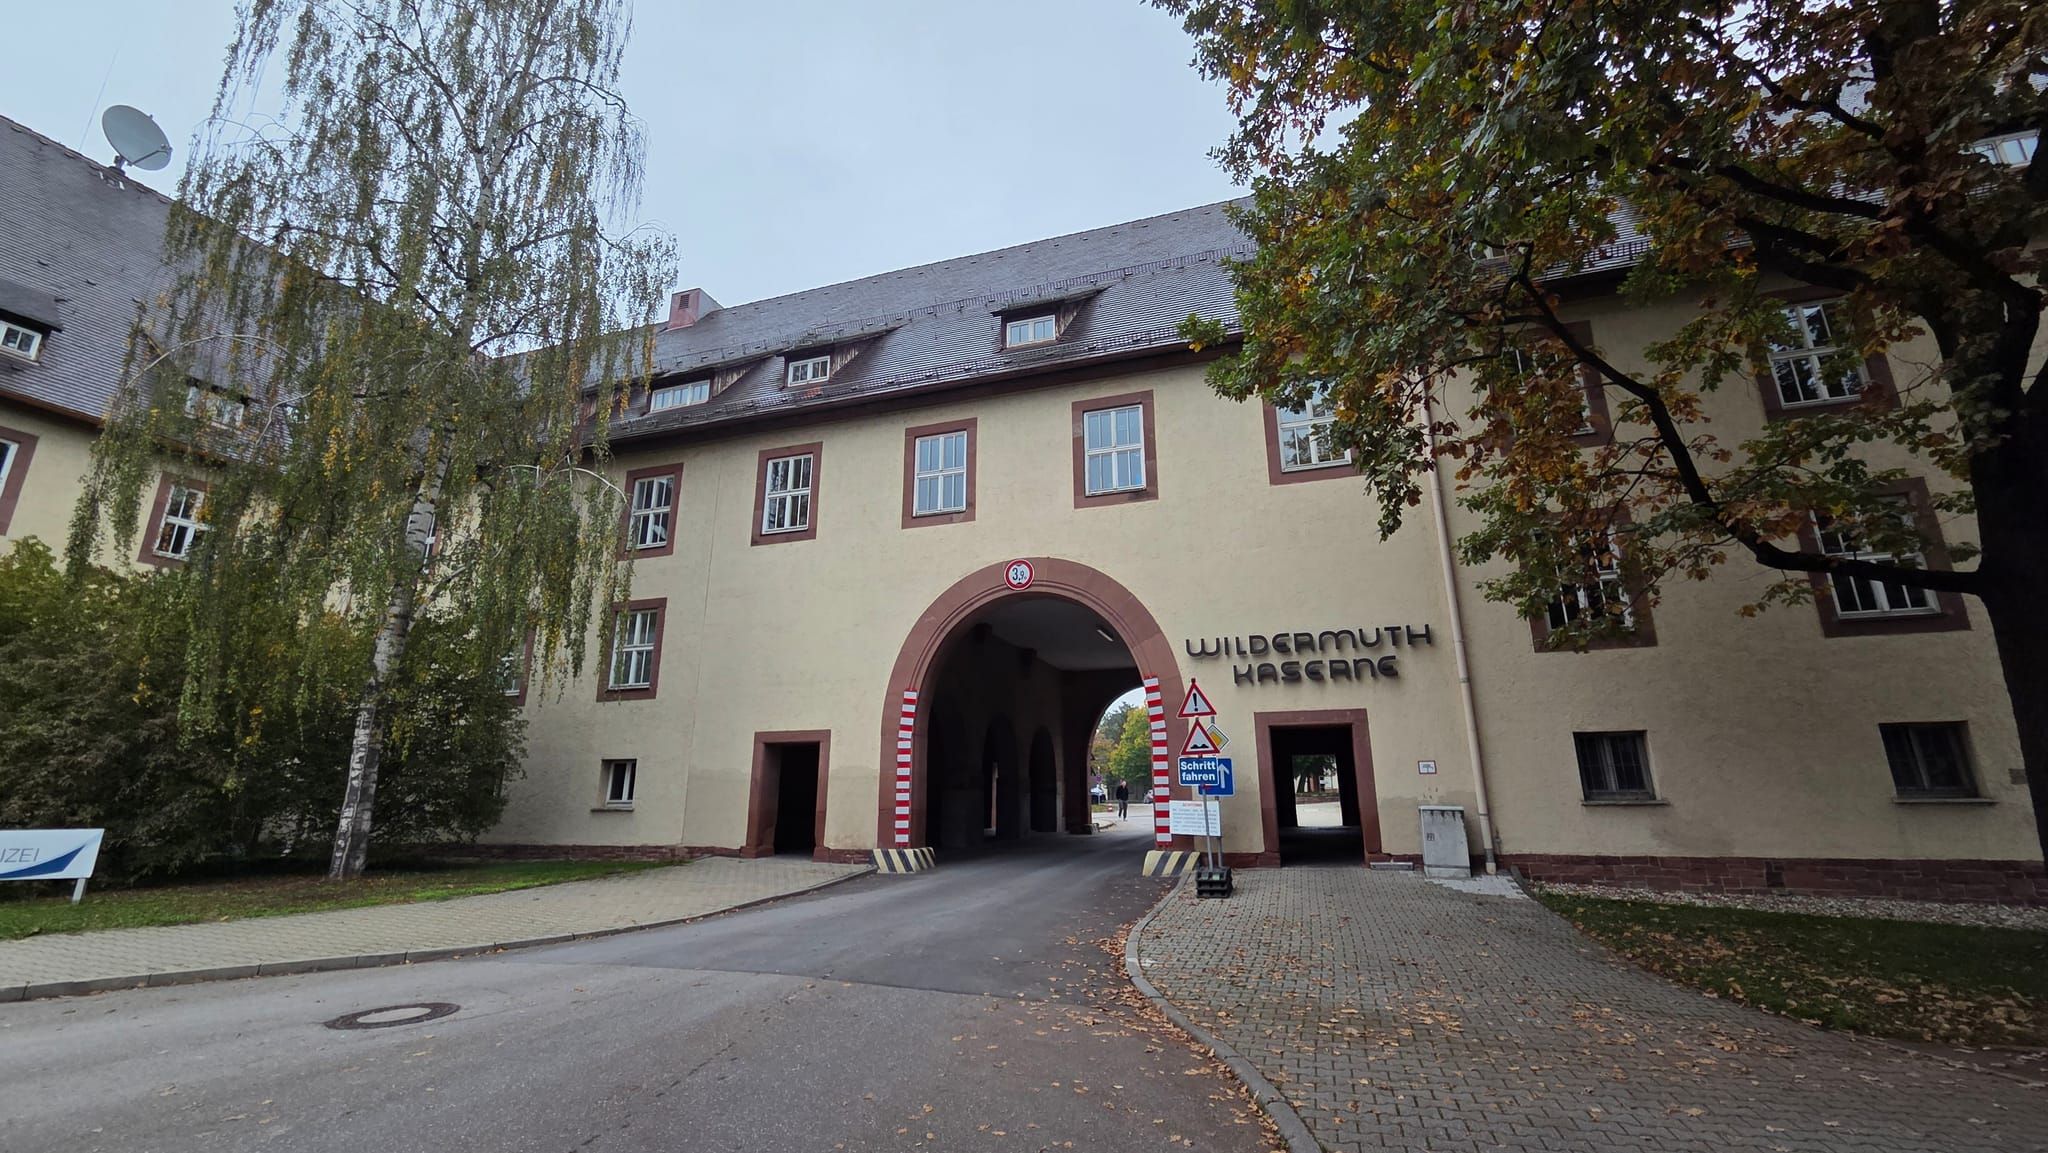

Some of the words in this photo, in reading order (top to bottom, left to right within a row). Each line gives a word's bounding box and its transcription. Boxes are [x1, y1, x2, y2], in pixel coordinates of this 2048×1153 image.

[1185, 624, 1432, 657] WILDERMUTH
[1233, 655, 1398, 685] KASERNE
[1180, 761, 1216, 770] Schritt
[1182, 772, 1215, 781] fahren
